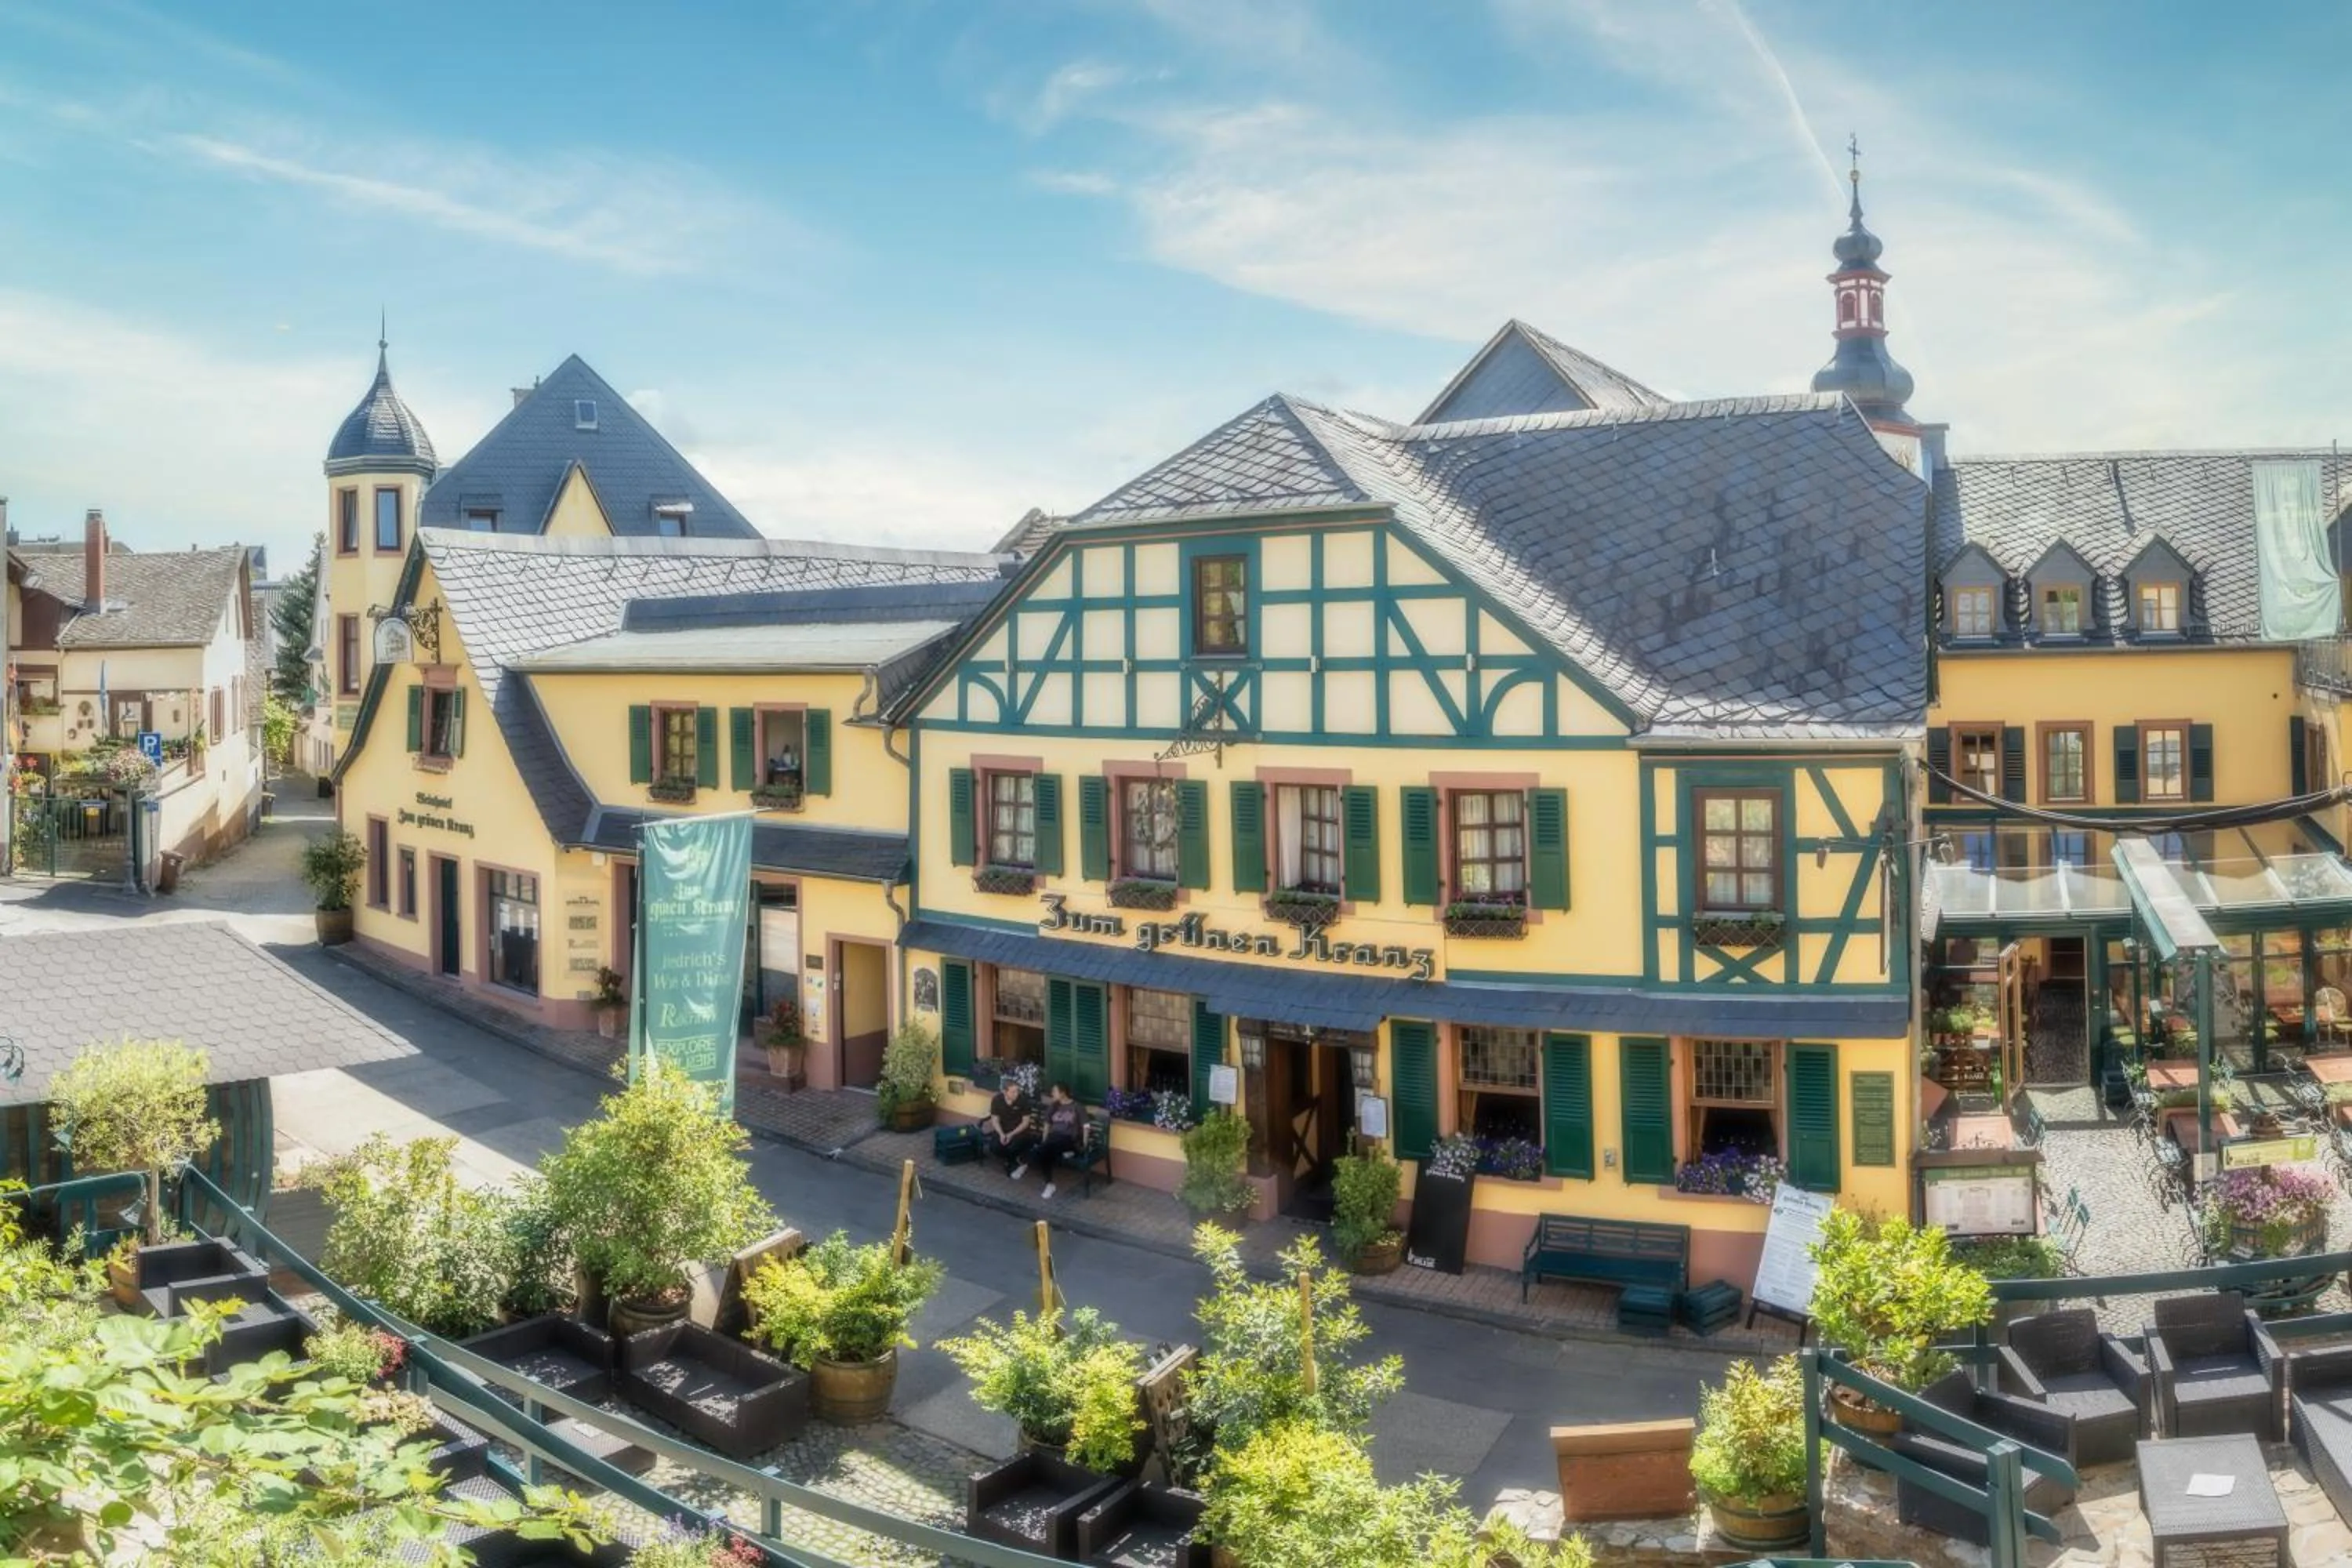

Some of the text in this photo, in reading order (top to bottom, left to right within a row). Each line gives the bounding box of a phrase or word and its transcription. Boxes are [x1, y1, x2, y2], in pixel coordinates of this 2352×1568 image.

[143, 735, 158, 753] P
[1039, 892, 1436, 982] Zum grünen Kranz
